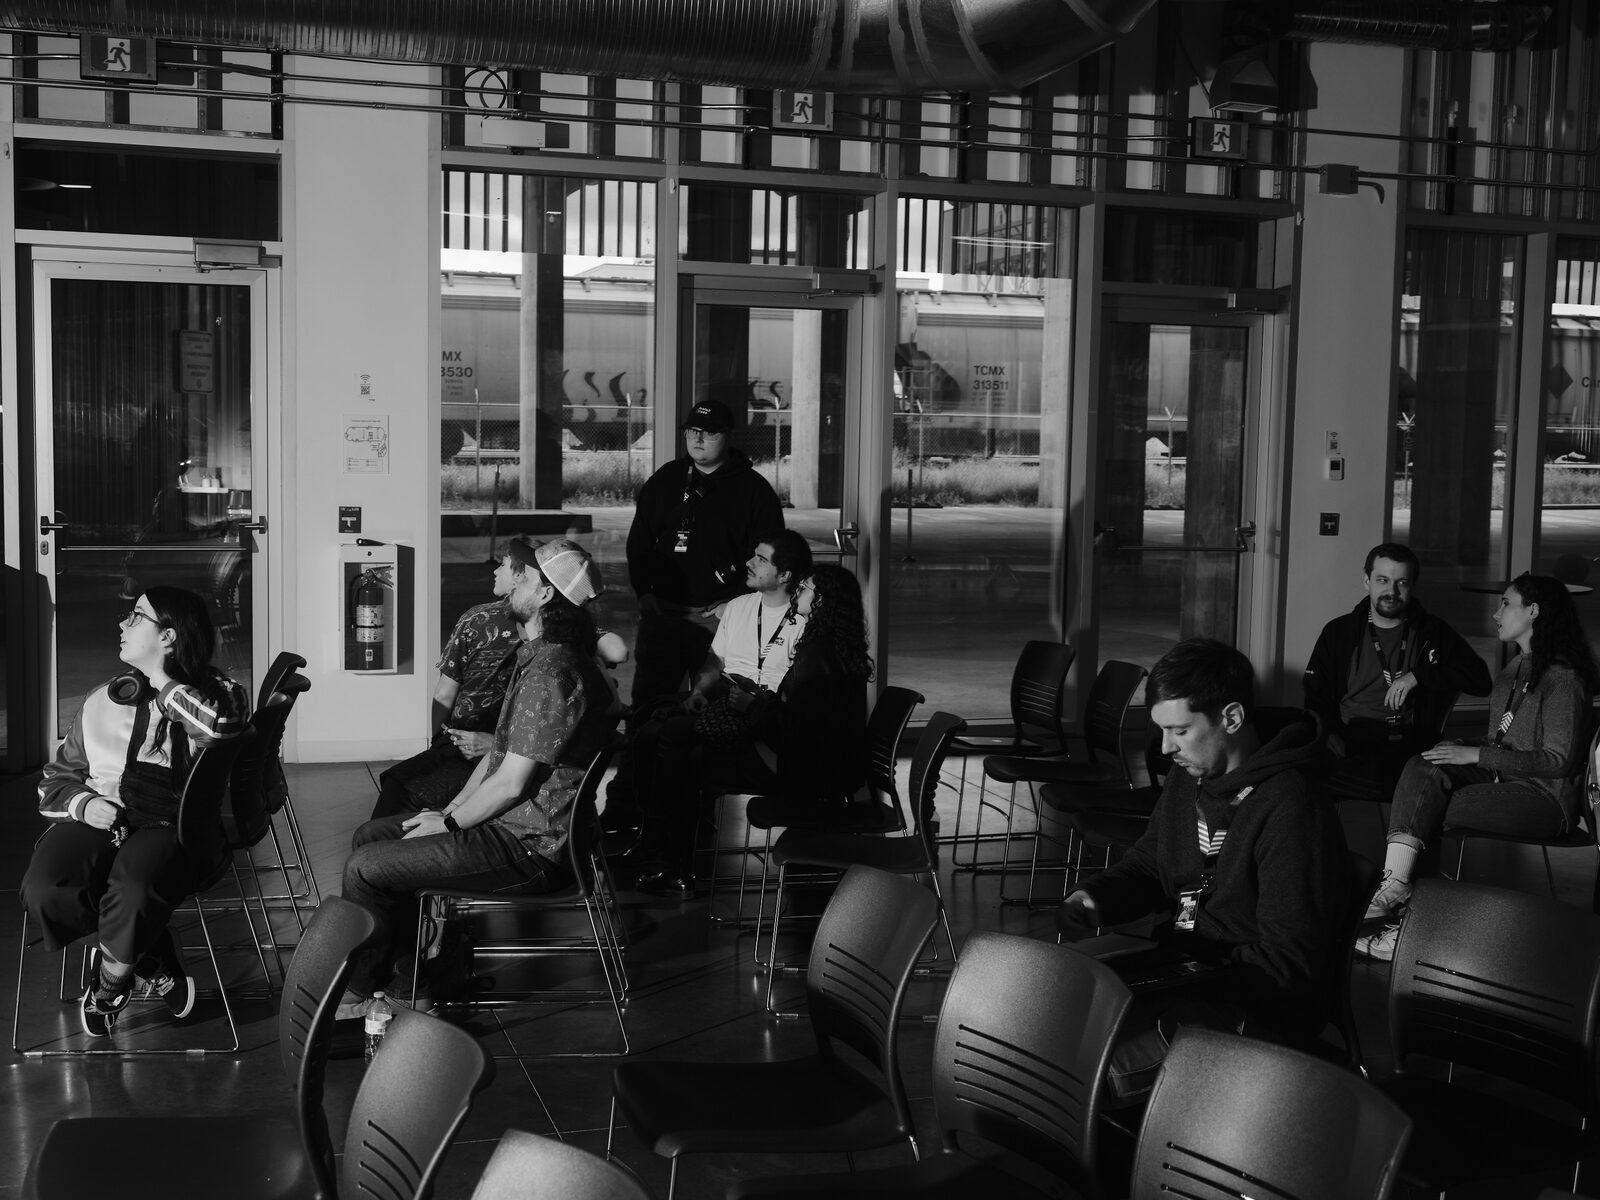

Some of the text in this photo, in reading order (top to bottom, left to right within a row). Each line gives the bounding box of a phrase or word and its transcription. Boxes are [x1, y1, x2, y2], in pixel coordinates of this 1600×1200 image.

[442, 351, 462, 362] MX
[973, 365, 1006, 376] TCMX
[973, 379, 1009, 391] 313511
